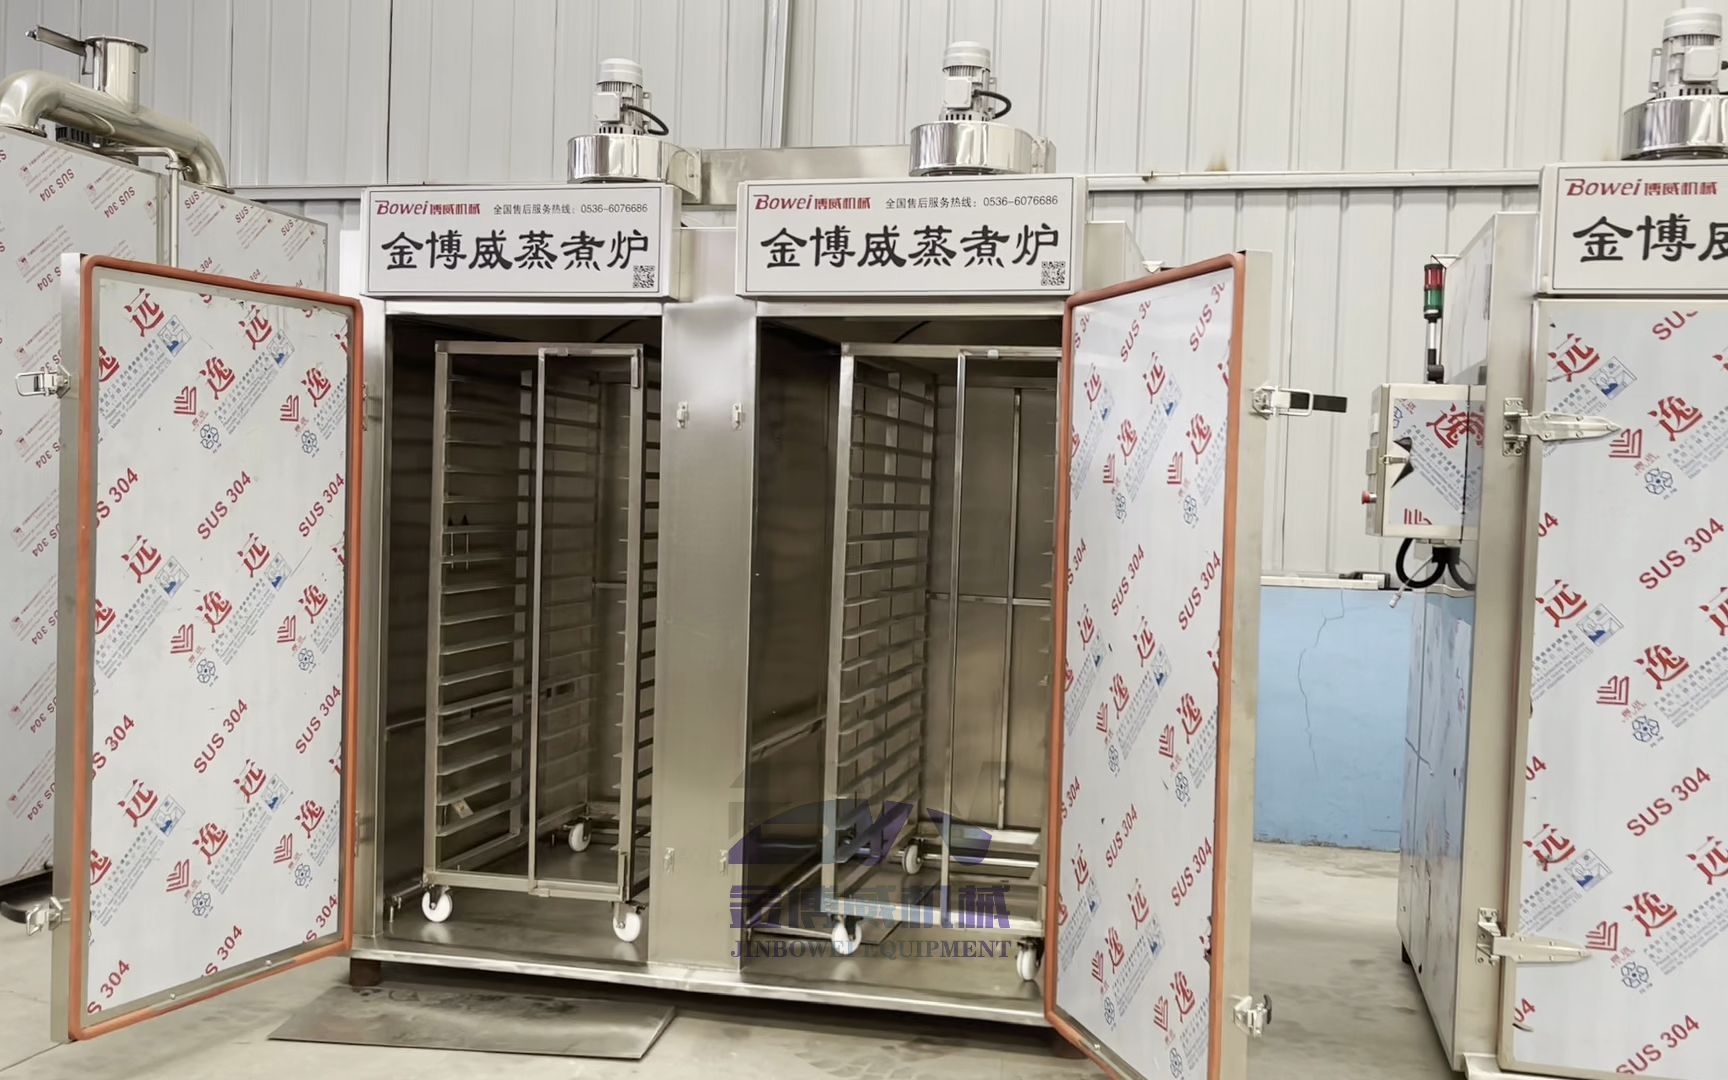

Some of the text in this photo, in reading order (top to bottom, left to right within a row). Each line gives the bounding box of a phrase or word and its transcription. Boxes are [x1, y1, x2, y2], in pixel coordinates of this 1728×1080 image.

[375, 200, 481, 215] Bowei 博威机械
[753, 194, 871, 210] Bowei 博威机械
[983, 195, 1058, 207] 0536-6076686
[1564, 178, 1718, 196] Bowei 博威机械
[580, 203, 648, 214] 0536-6076686
[381, 229, 649, 271] 金博威蒸煮炉
[760, 223, 1059, 269] 金博威蒸煮炉
[1120, 320, 1140, 362] SUS
[1190, 304, 1212, 352] SUS
[1652, 310, 1698, 341] SU
[109, 468, 138, 503] 304
[197, 471, 251, 540] SUS 304
[299, 473, 345, 537] SUS 304
[1639, 518, 1725, 590] SUS 304
[1111, 544, 1145, 616] SUS 304
[1178, 551, 1222, 631] SUS 304
[105, 715, 135, 752] 304
[194, 733, 224, 774] SUS
[222, 699, 248, 733] 304
[295, 685, 341, 754] SUS 304
[1626, 767, 1711, 837] SUS 304
[1105, 803, 1139, 869] SUS 304
[1171, 837, 1213, 907] SUS 304
[316, 895, 338, 928] 304
[217, 925, 243, 960] 304
[100, 960, 130, 998] 304
[1660, 1015, 1700, 1049] 304
